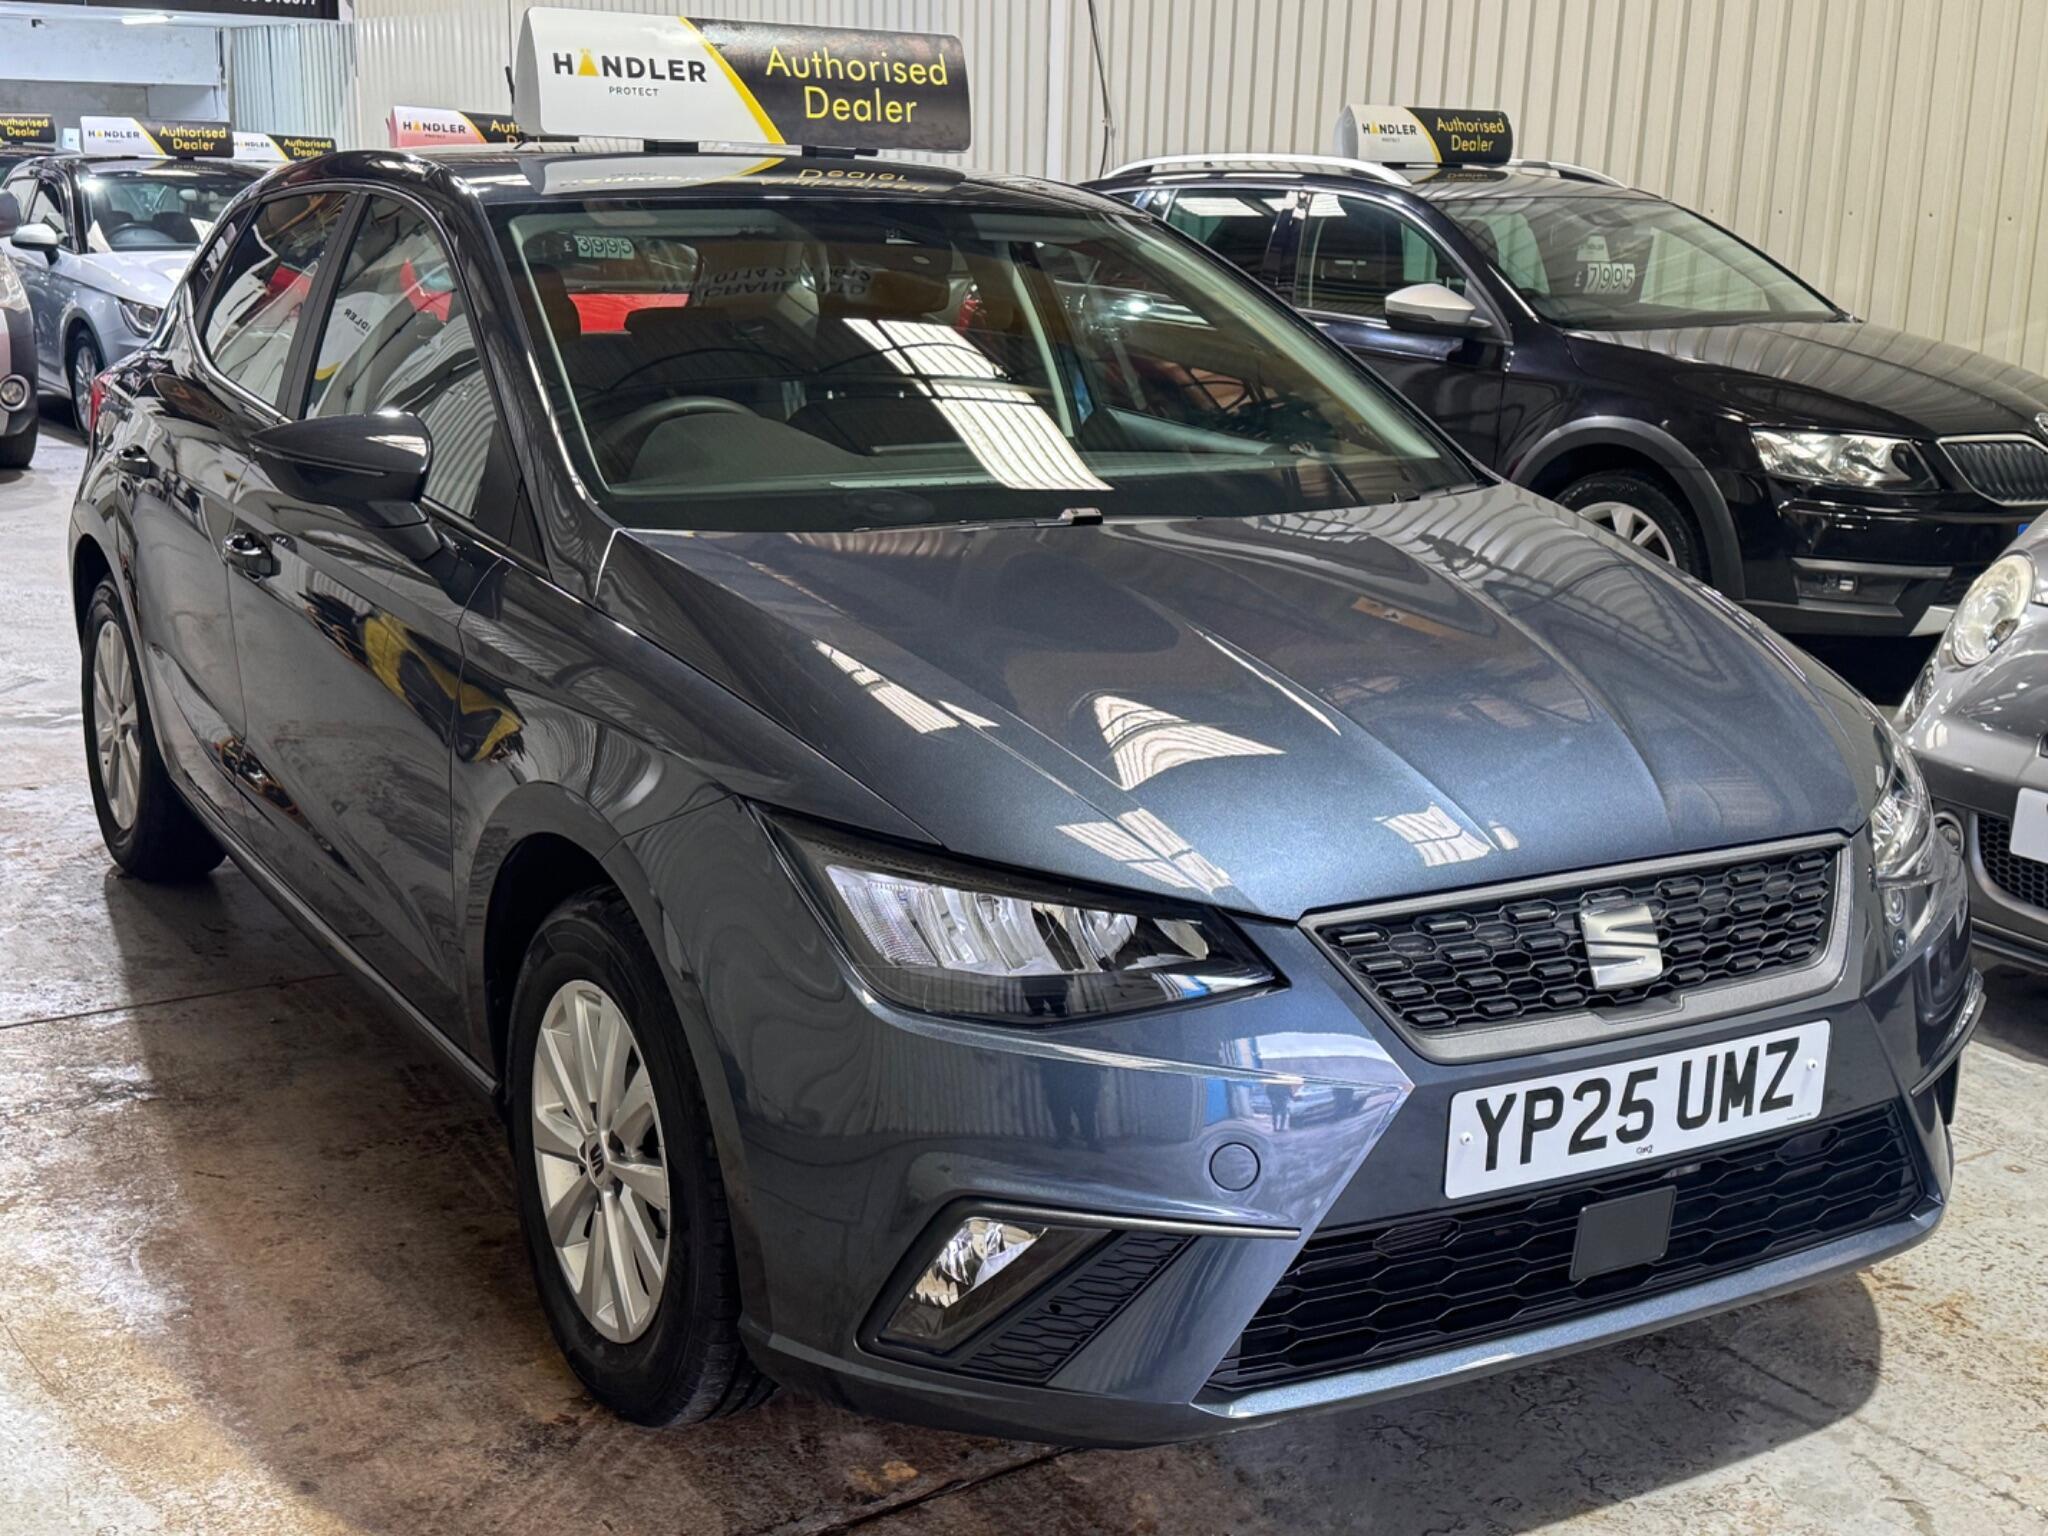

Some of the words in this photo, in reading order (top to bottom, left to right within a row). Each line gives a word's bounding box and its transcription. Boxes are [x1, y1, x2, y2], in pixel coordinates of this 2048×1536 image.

[765, 47, 948, 86] Authorised
[609, 86, 659, 96] PROTECT
[803, 86, 917, 123] Dealer
[6, 127, 40, 137] Dealer
[159, 126, 226, 139] Authorised
[1437, 116, 1505, 134] Authorised
[173, 139, 214, 150] Dealer
[283, 138, 332, 149] Authorised
[1451, 134, 1494, 152] Dealer
[1475, 1066, 1659, 1171] YP25
[1676, 1037, 1800, 1131] UMZ
